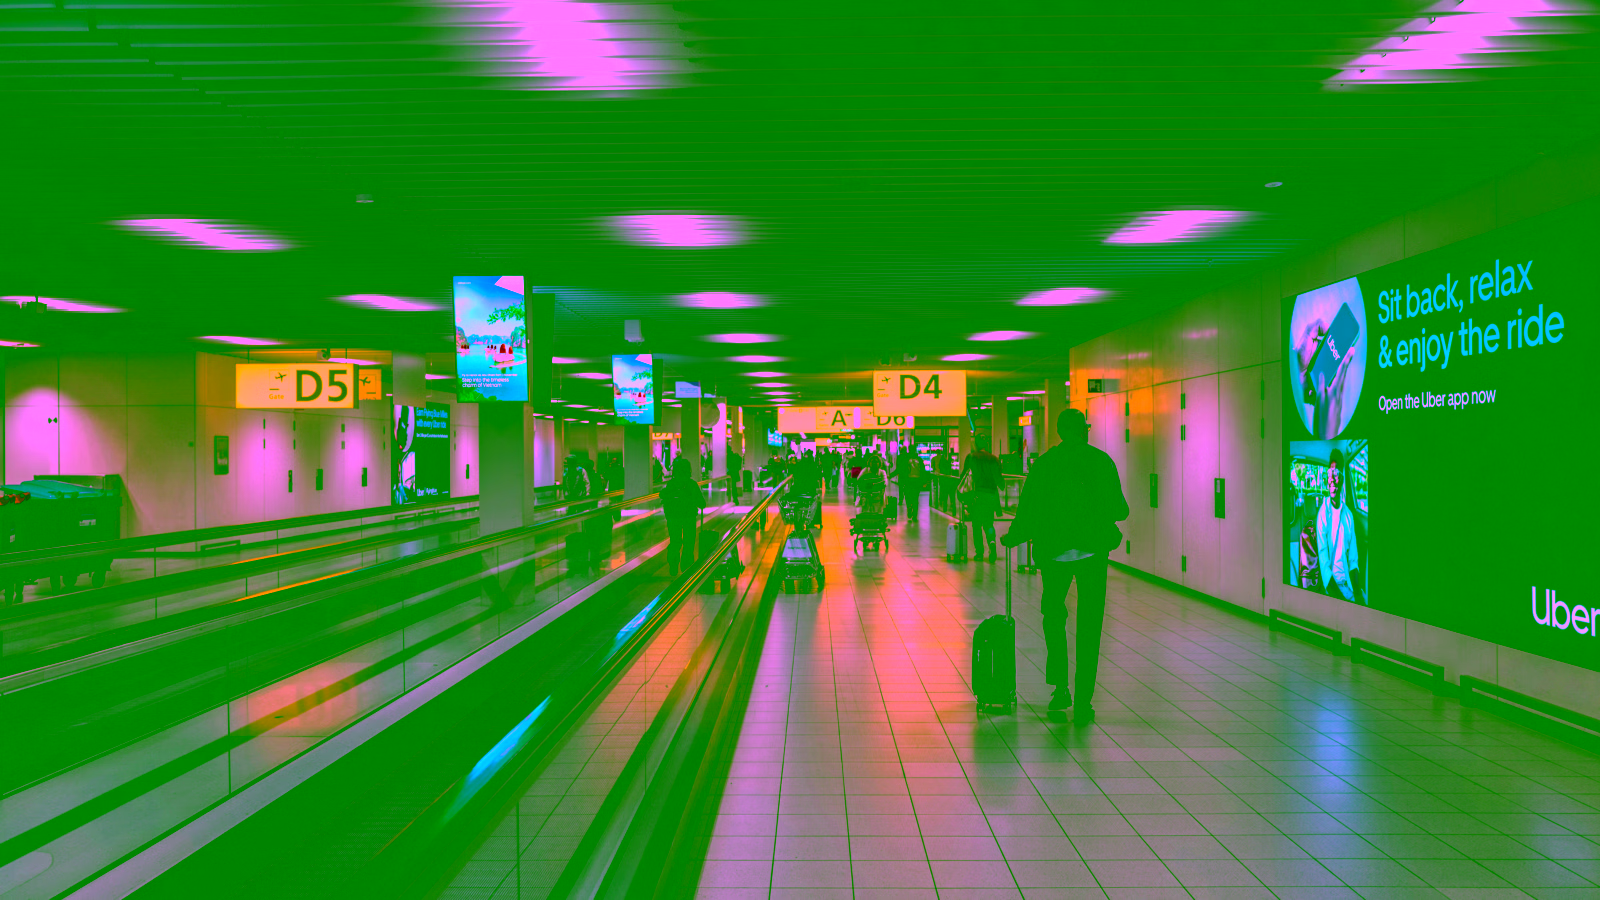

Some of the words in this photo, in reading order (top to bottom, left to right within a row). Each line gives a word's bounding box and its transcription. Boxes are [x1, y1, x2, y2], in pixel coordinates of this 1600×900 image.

[1378, 288, 1402, 324] Sit
[1406, 272, 1463, 318] back,
[1469, 258, 1533, 304] relax
[1327, 334, 1341, 361] Uber
[1378, 334, 1393, 369] &
[1395, 327, 1454, 373] enjoy
[1457, 318, 1501, 356] the
[1507, 303, 1565, 350] ride
[295, 368, 348, 403] D5
[899, 374, 943, 400] D4
[1378, 395, 1403, 414] Open
[1404, 393, 1420, 409] the
[1421, 391, 1446, 408] Uber
[1447, 391, 1470, 410] app
[1471, 389, 1497, 405] now
[830, 409, 847, 426] A
[1531, 586, 1600, 637] Uber
